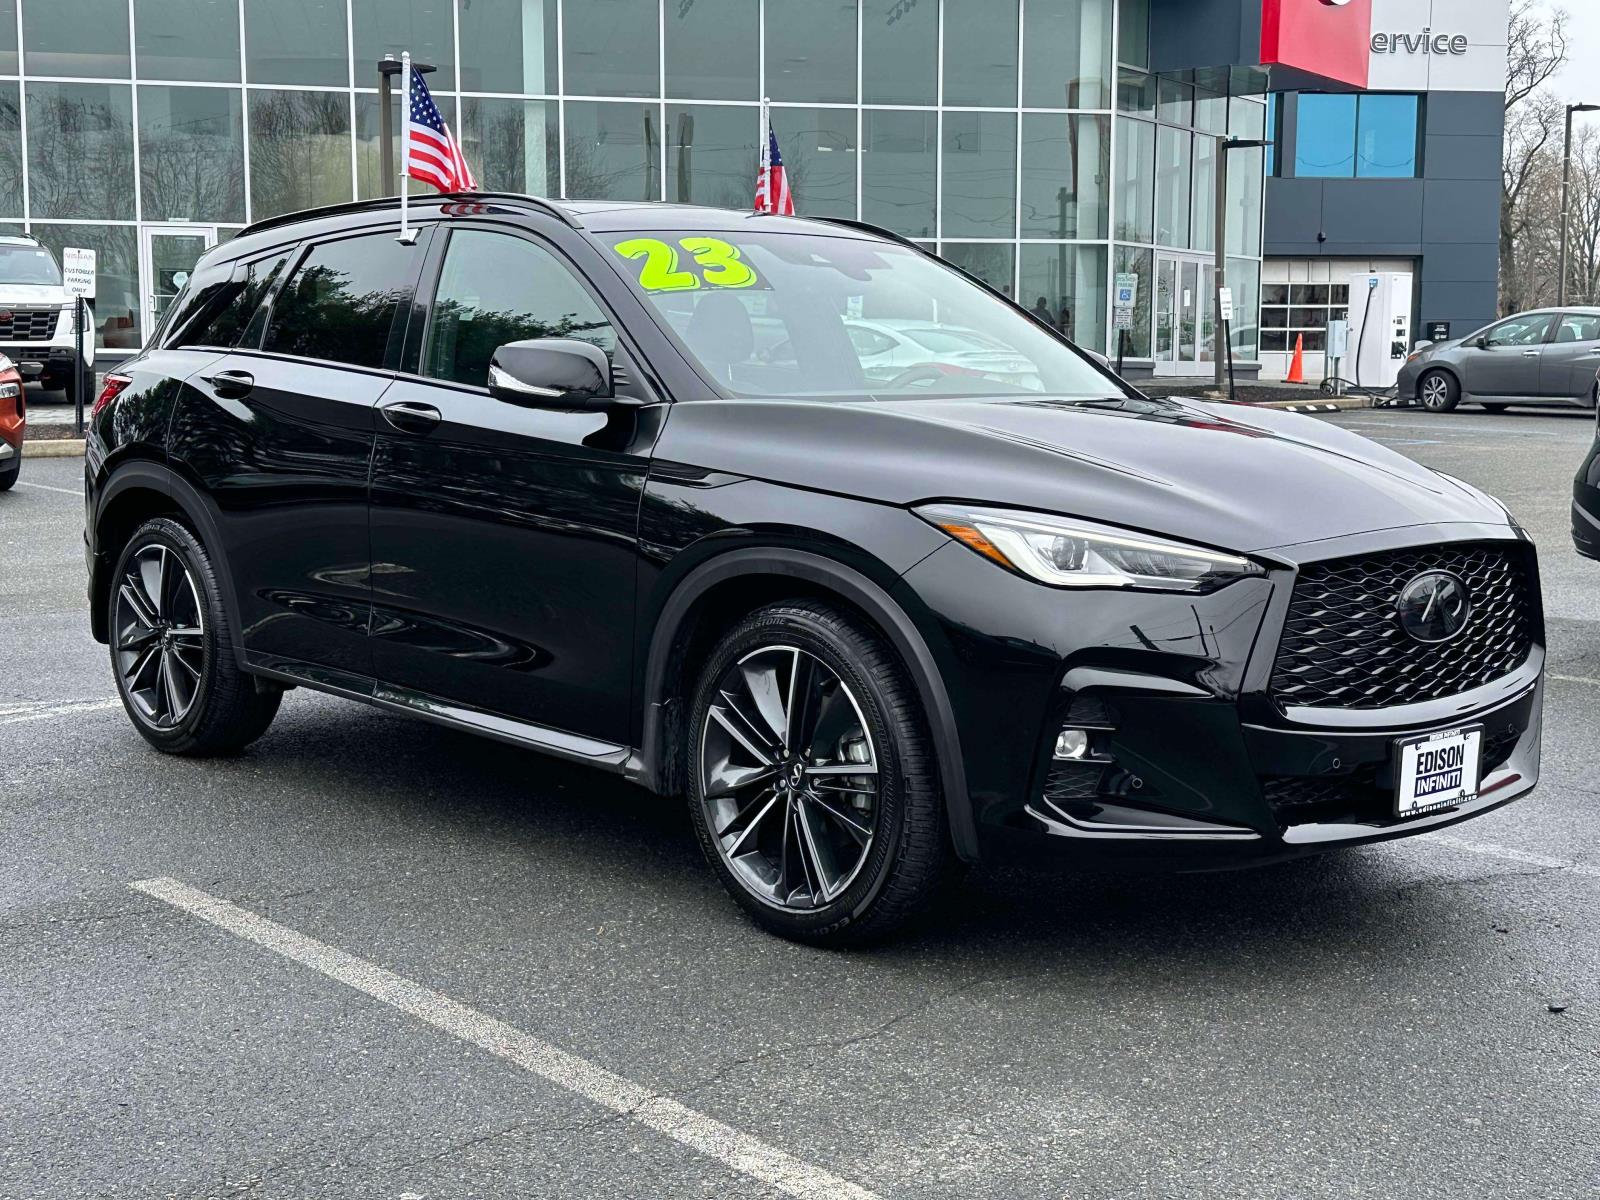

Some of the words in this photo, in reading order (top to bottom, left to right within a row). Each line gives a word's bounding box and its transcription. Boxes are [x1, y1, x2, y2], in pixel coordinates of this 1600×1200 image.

[1370, 27, 1468, 55] ervice
[65, 267, 94, 275] CUSTOMER
[614, 237, 757, 290] 23
[67, 277, 91, 285] PARKING
[1416, 743, 1465, 776] EDISON
[1416, 770, 1461, 795] INFINITI
